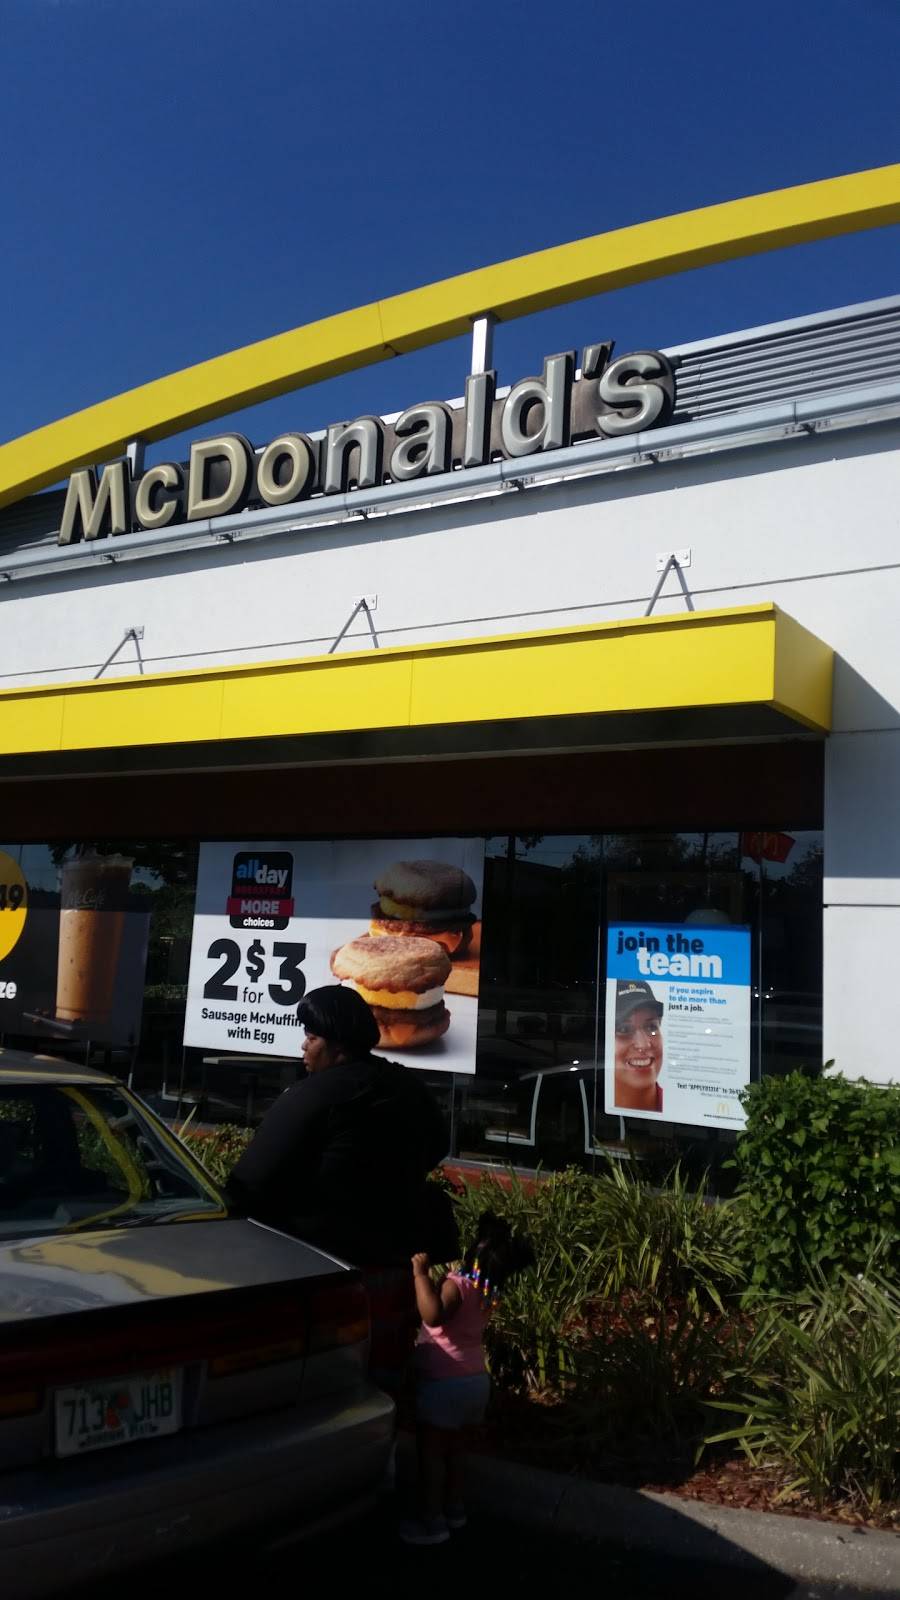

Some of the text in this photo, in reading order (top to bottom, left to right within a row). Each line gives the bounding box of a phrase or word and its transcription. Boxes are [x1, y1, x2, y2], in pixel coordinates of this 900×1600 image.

[58, 340, 675, 546] McDonald's
[236, 859, 289, 888] all day
[240, 900, 280, 914] MORE
[243, 917, 275, 928] choices
[616, 930, 704, 954] join the
[636, 947, 723, 978] team
[243, 987, 263, 1004] for
[676, 987, 690, 995] you
[690, 988, 714, 996] aspire
[668, 1003, 683, 1011] just
[690, 1004, 705, 1012] job.
[201, 1008, 302, 1027] Sausage McMuffin
[227, 1027, 275, 1044] with Egg
[134, 1383, 173, 1421] JHB
